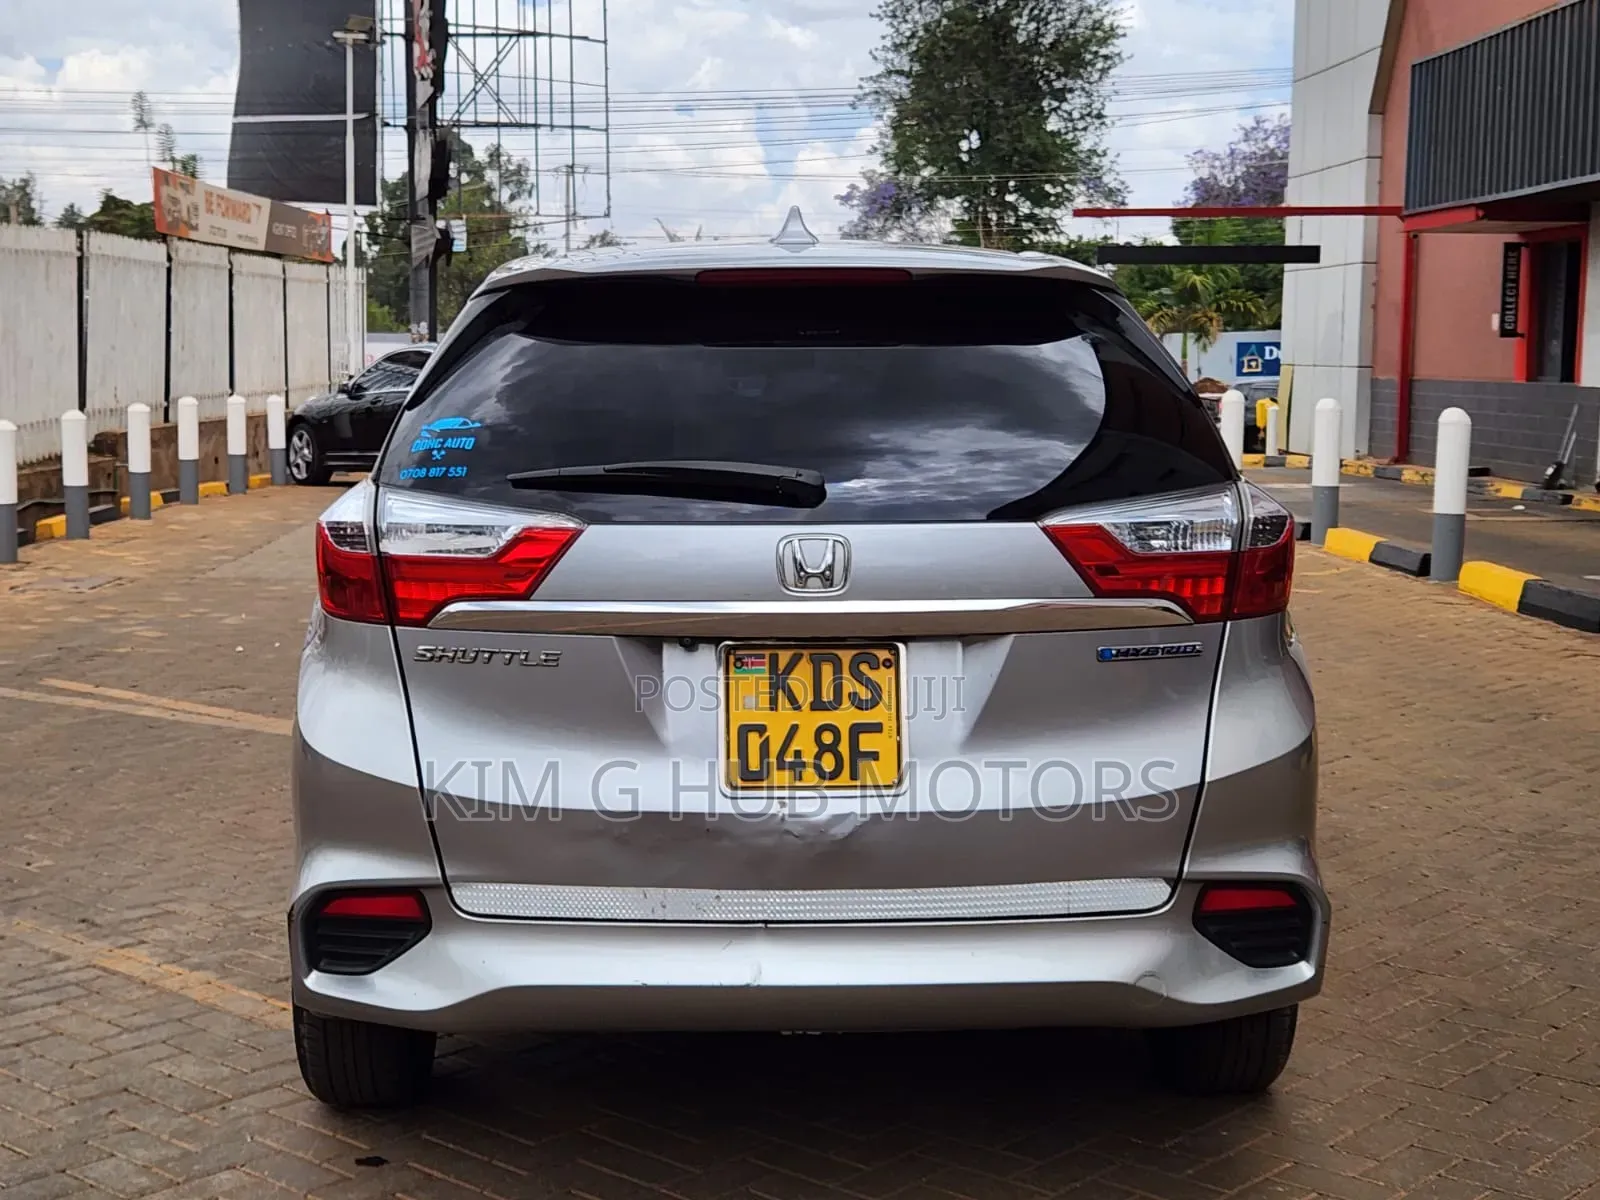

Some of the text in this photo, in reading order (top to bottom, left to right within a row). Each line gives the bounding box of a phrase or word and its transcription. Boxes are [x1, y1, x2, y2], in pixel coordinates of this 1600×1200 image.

[1504, 251, 1519, 330] COLLECT HERE
[444, 437, 476, 450] AUTO
[400, 465, 468, 480] 0708 817 551
[413, 644, 562, 667] SHUTTLE
[1112, 643, 1203, 660] HYBRID
[767, 652, 884, 712] KDS
[736, 722, 884, 783] 048F
